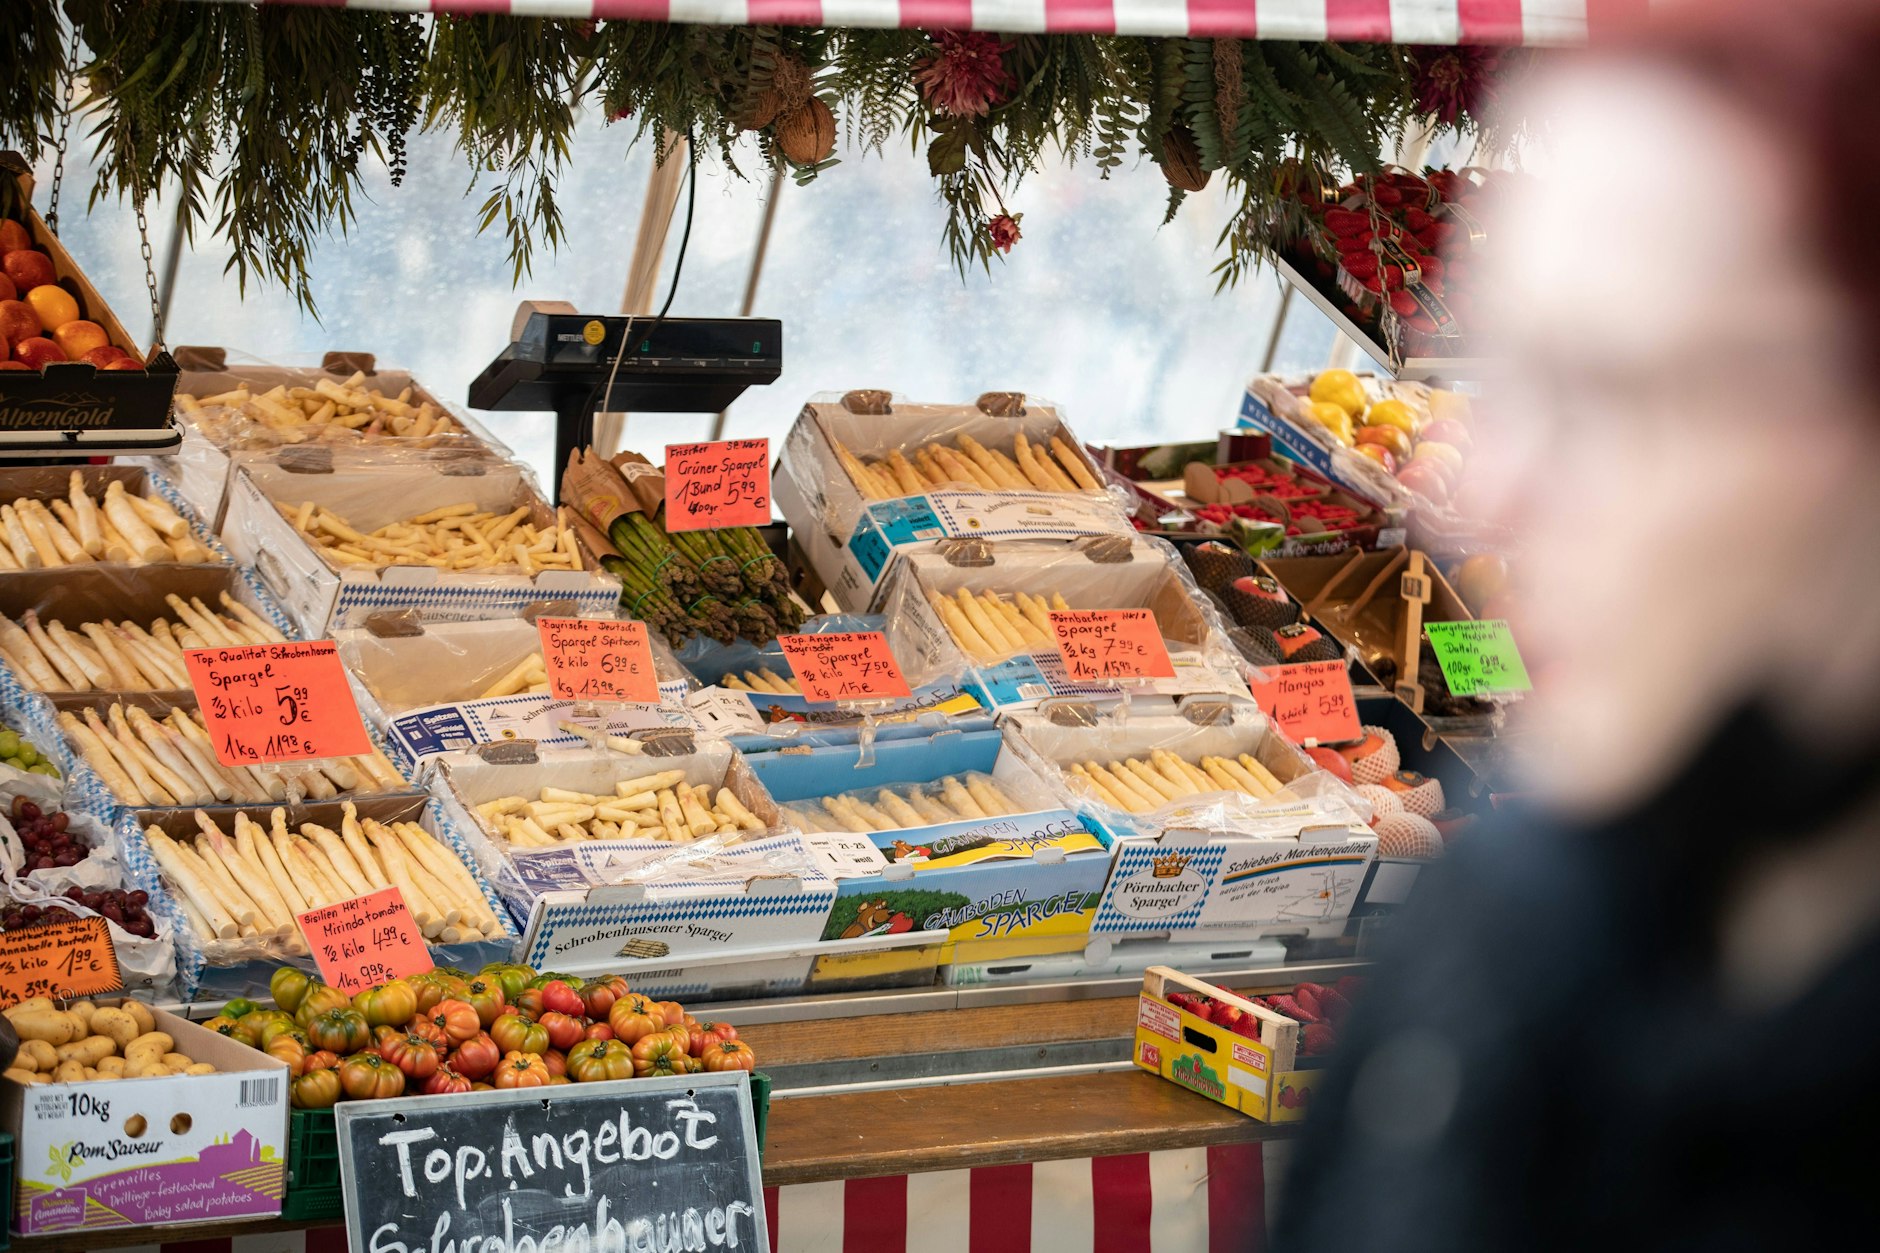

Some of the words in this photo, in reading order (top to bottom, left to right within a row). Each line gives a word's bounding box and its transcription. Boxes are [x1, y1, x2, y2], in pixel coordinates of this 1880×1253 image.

[670, 445, 709, 458] Frischer
[678, 460, 718, 475] Grüner
[720, 453, 766, 478] Spargel
[690, 475, 722, 496] Bund
[754, 496, 766, 508] €
[1057, 622, 1117, 638] Spargel
[551, 634, 598, 655] Spargel
[601, 635, 640, 647] Spitzen
[809, 634, 852, 646] Angebot
[818, 648, 872, 670] Spargel
[1080, 643, 1097, 658] kg
[1137, 645, 1148, 656] €
[568, 656, 588, 668] kilo
[630, 663, 640, 674] €
[819, 668, 843, 679] kilo
[888, 670, 896, 678] €
[210, 664, 275, 691] Spargel
[558, 678, 574, 698] kg
[615, 688, 628, 699] €
[813, 686, 830, 698] kg
[1278, 679, 1325, 696] Mangos
[228, 696, 263, 719] kilo
[301, 710, 312, 722] €
[423, 712, 460, 724] Spitzen
[303, 741, 316, 754] €
[932, 820, 1021, 855] GÄUBODEN
[1226, 852, 1282, 874] Schiebels
[1284, 842, 1371, 860] Markenqualität
[1123, 880, 1200, 896] Pörnbacher
[1248, 889, 1261, 897] der
[1264, 884, 1290, 894] Region
[922, 888, 1028, 932] GÄUBODEN
[1130, 894, 1182, 911] Spargel
[304, 910, 338, 924] Sisilien
[976, 888, 1092, 938] SPARGEL
[342, 938, 365, 959] kilo
[400, 932, 411, 946] €
[554, 923, 684, 956] Schrobenhausener
[684, 922, 734, 944] Spargel
[0, 940, 53, 956] Annabelle
[20, 956, 48, 970] kilo
[90, 960, 103, 972] €
[50, 983, 60, 996] €
[94, 1169, 162, 1196] Grenailles
[144, 1204, 172, 1222] Baby
[176, 1196, 204, 1213] salad
[206, 1192, 252, 1212] potatoes
